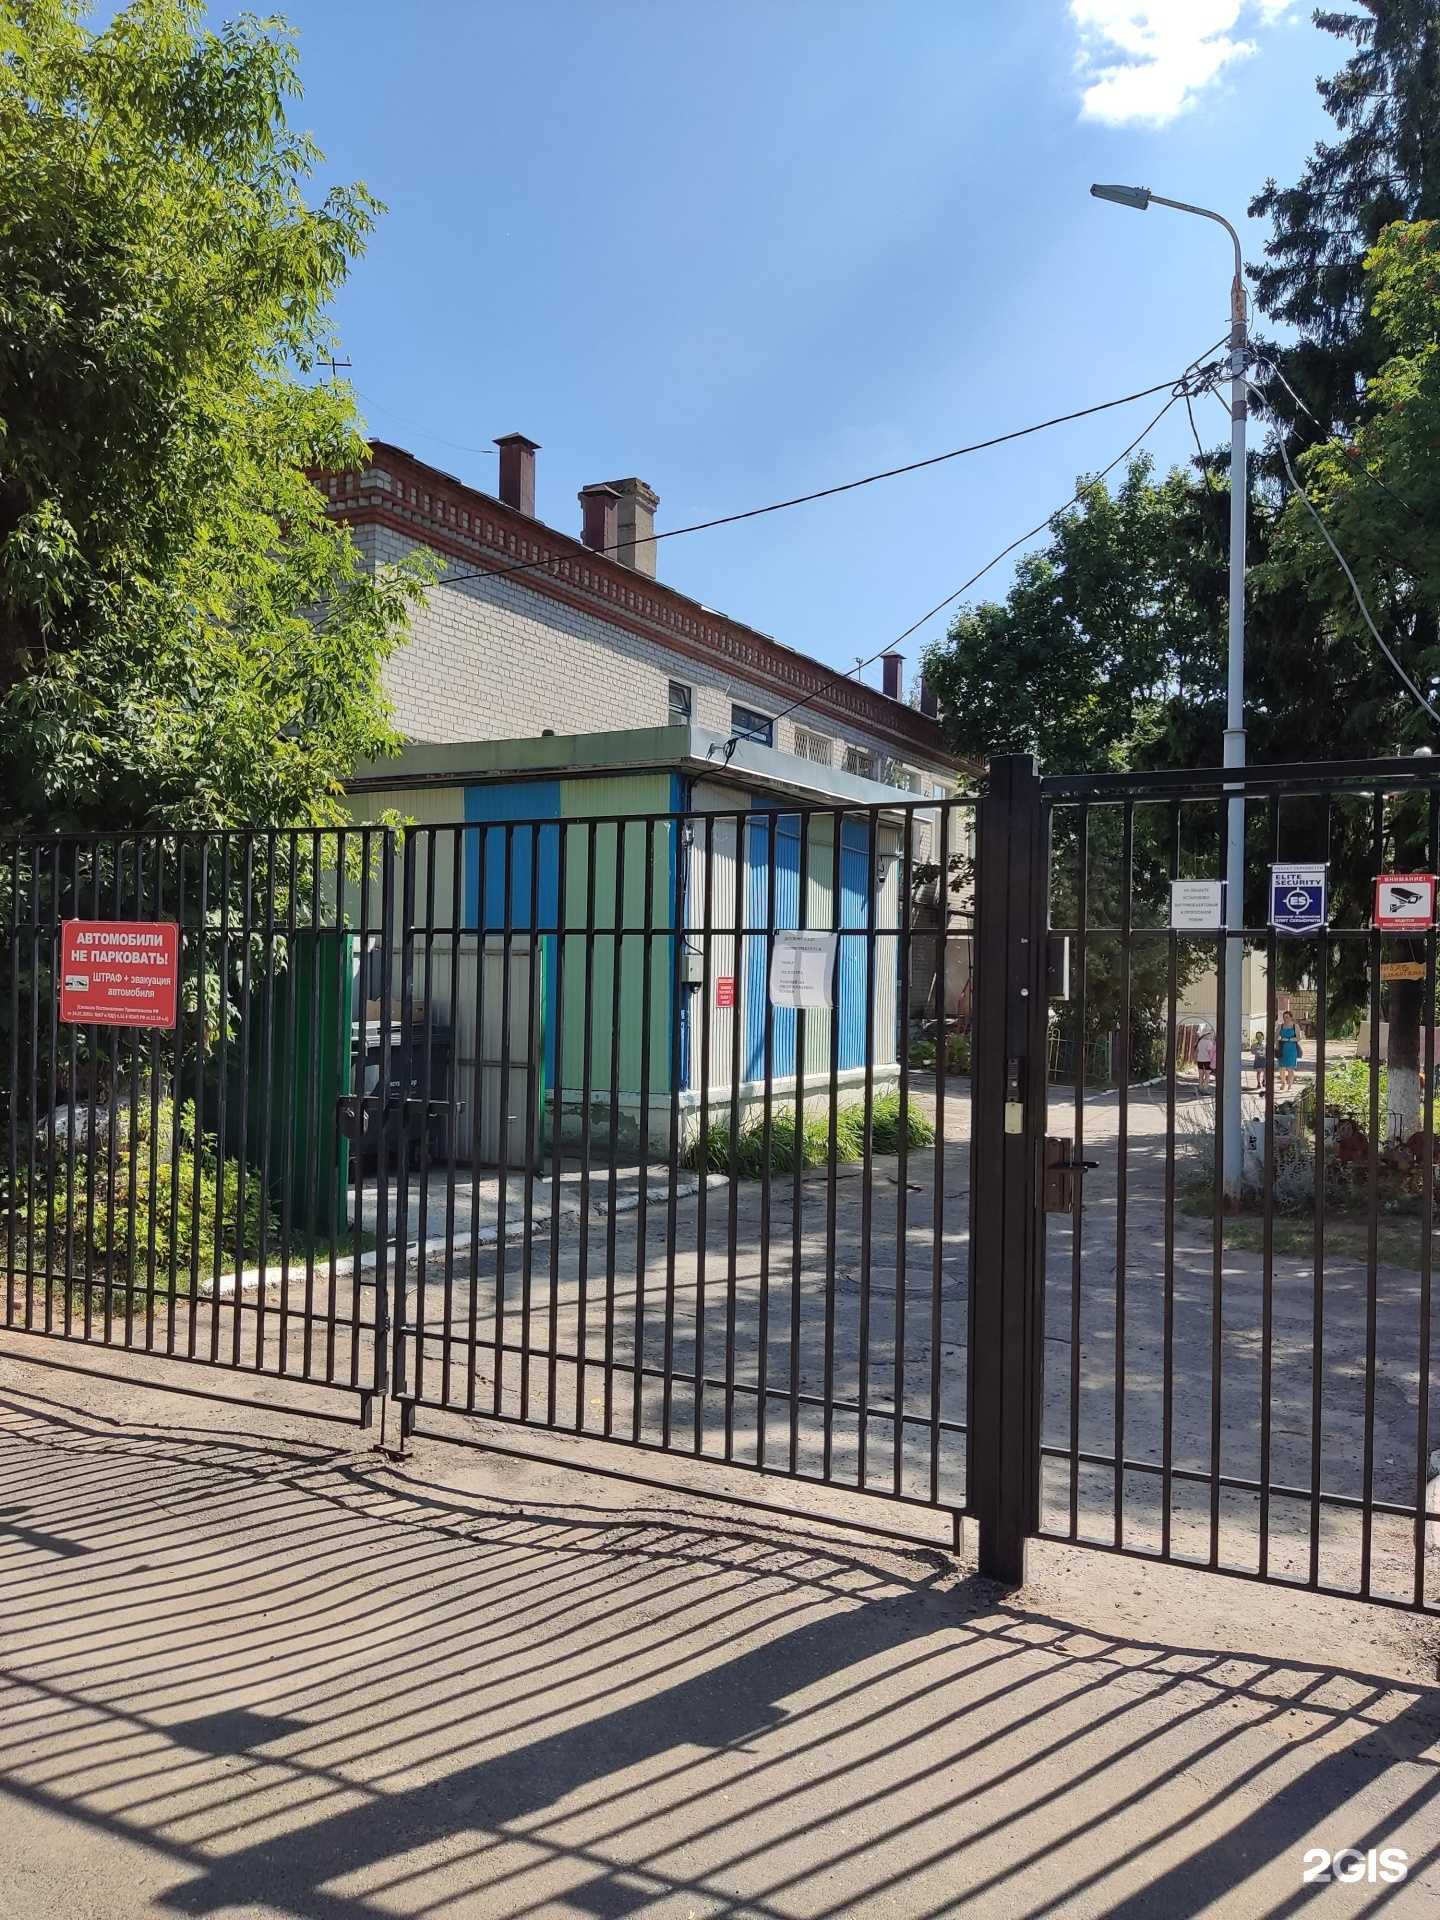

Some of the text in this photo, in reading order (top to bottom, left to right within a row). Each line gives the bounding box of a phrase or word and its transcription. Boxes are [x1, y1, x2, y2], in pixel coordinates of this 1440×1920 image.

[1290, 896, 1307, 906] ES
[76, 932, 163, 947] АВТОМОБИЛИ
[71, 949, 169, 965] НЕ ПАРКОВАТЬ!
[92, 972, 123, 983] ШТРАФ
[130, 976, 171, 986] эвакуация
[107, 987, 155, 998] автомобиля
